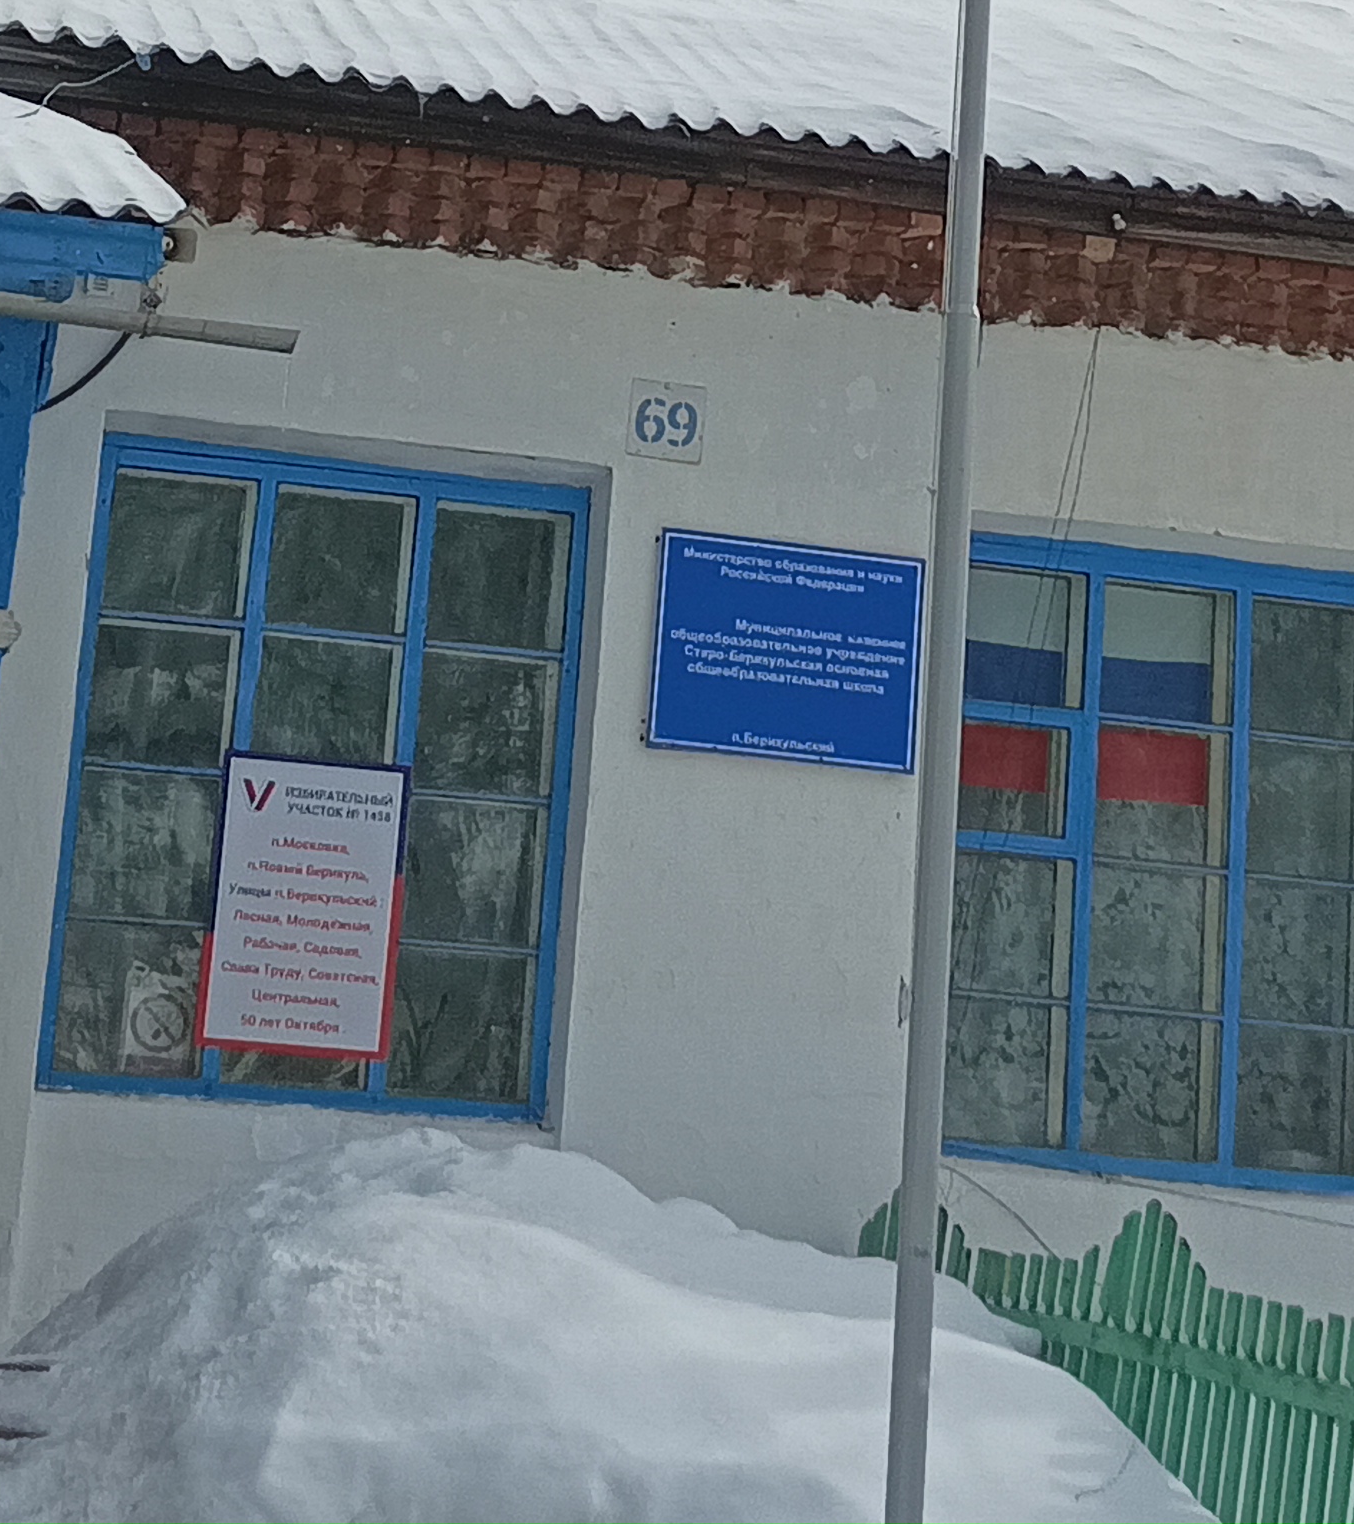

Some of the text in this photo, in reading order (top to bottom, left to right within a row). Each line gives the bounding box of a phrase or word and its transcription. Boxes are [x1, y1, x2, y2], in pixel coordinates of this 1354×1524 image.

[635, 396, 698, 448] 69
[683, 545, 904, 586] Министерство образования и науки
[720, 565, 865, 594] Российской Федерации
[735, 617, 842, 643] Муниципальное
[670, 628, 906, 667] общеобразовательное учреждение
[686, 661, 885, 697] общеобразовательная школа
[825, 663, 890, 680] основная
[284, 786, 394, 808] ИЗБИРАТЕЛЬНЫЙ
[286, 801, 392, 823] УЧАСТОК № 1458
[229, 883, 272, 899] Улицы
[233, 909, 283, 926] Лесная,
[243, 935, 362, 960] Рабочая, Садовая,
[308, 967, 380, 986] Советская,
[240, 1013, 256, 1028] 50
[258, 1018, 281, 1029] лет
